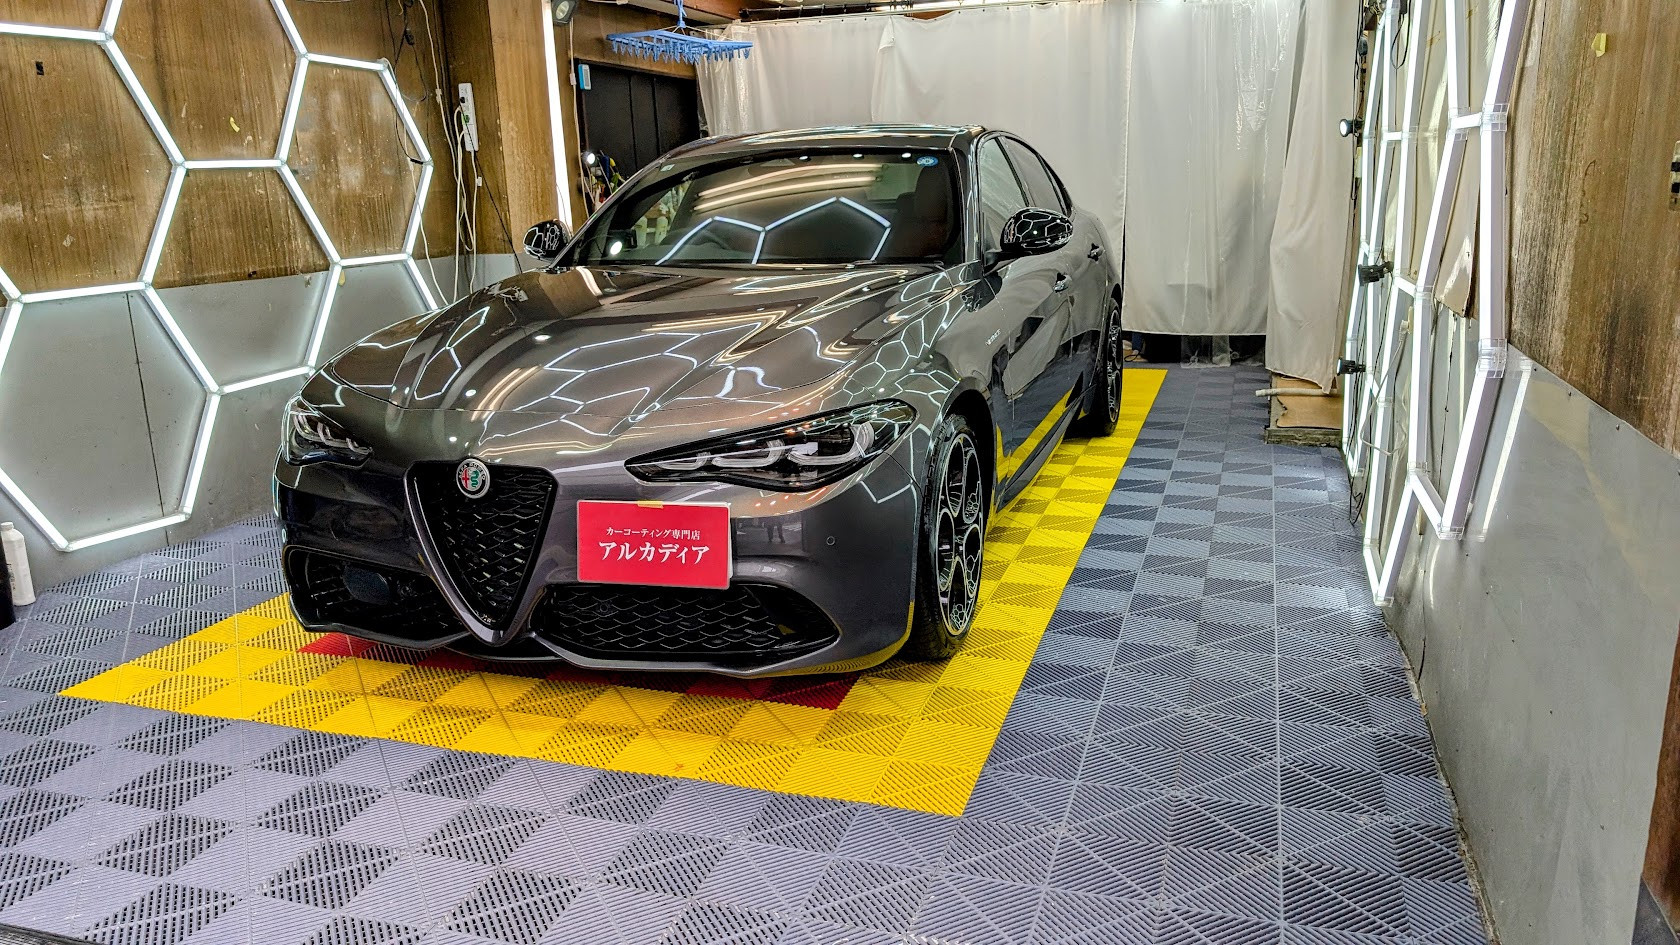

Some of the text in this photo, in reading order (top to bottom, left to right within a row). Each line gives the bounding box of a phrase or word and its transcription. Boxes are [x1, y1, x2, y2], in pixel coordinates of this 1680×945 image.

[606, 527, 701, 541] カーコーティング専門店
[598, 541, 710, 565] アルカディア
